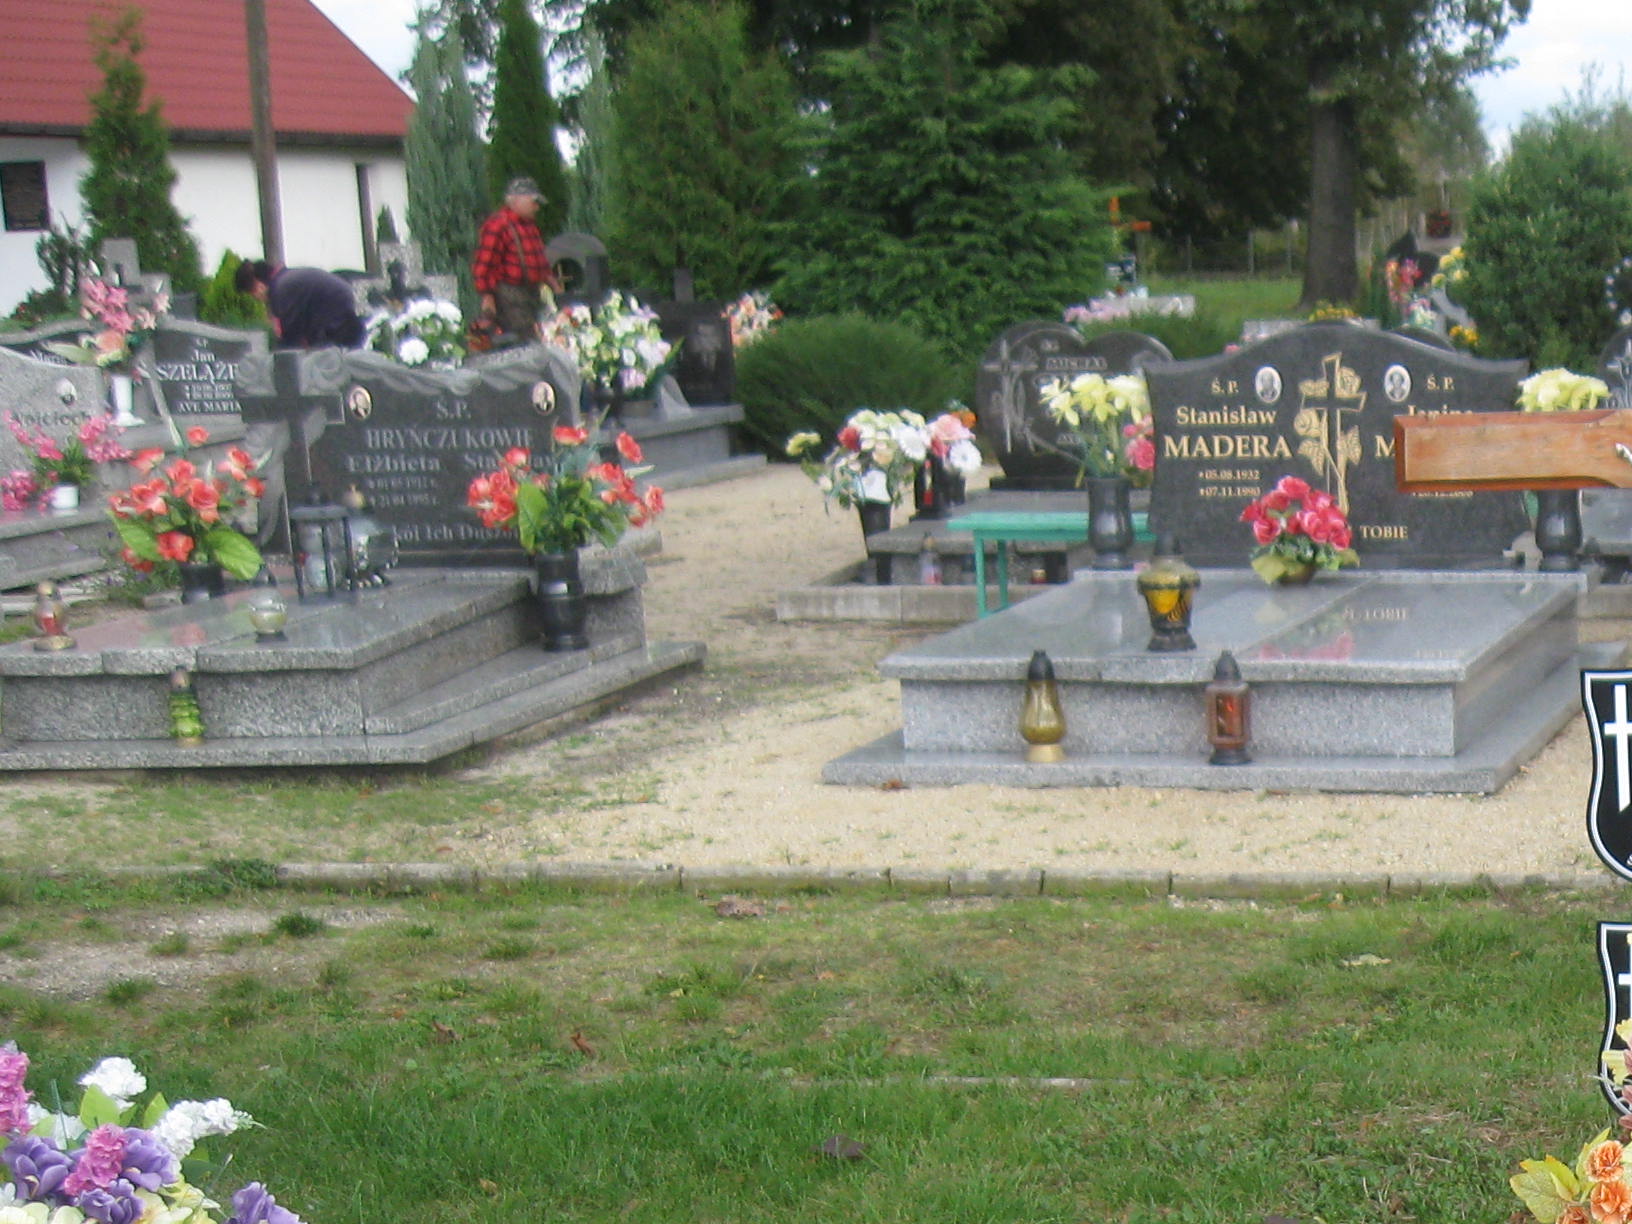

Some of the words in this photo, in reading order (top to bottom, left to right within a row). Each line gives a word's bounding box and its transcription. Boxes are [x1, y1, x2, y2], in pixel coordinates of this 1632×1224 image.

[1175, 405, 1277, 425] Stanisław
[1163, 434, 1293, 458] MADERA
[347, 451, 441, 473] Elżbieta
[1359, 525, 1408, 540] TOBIE
